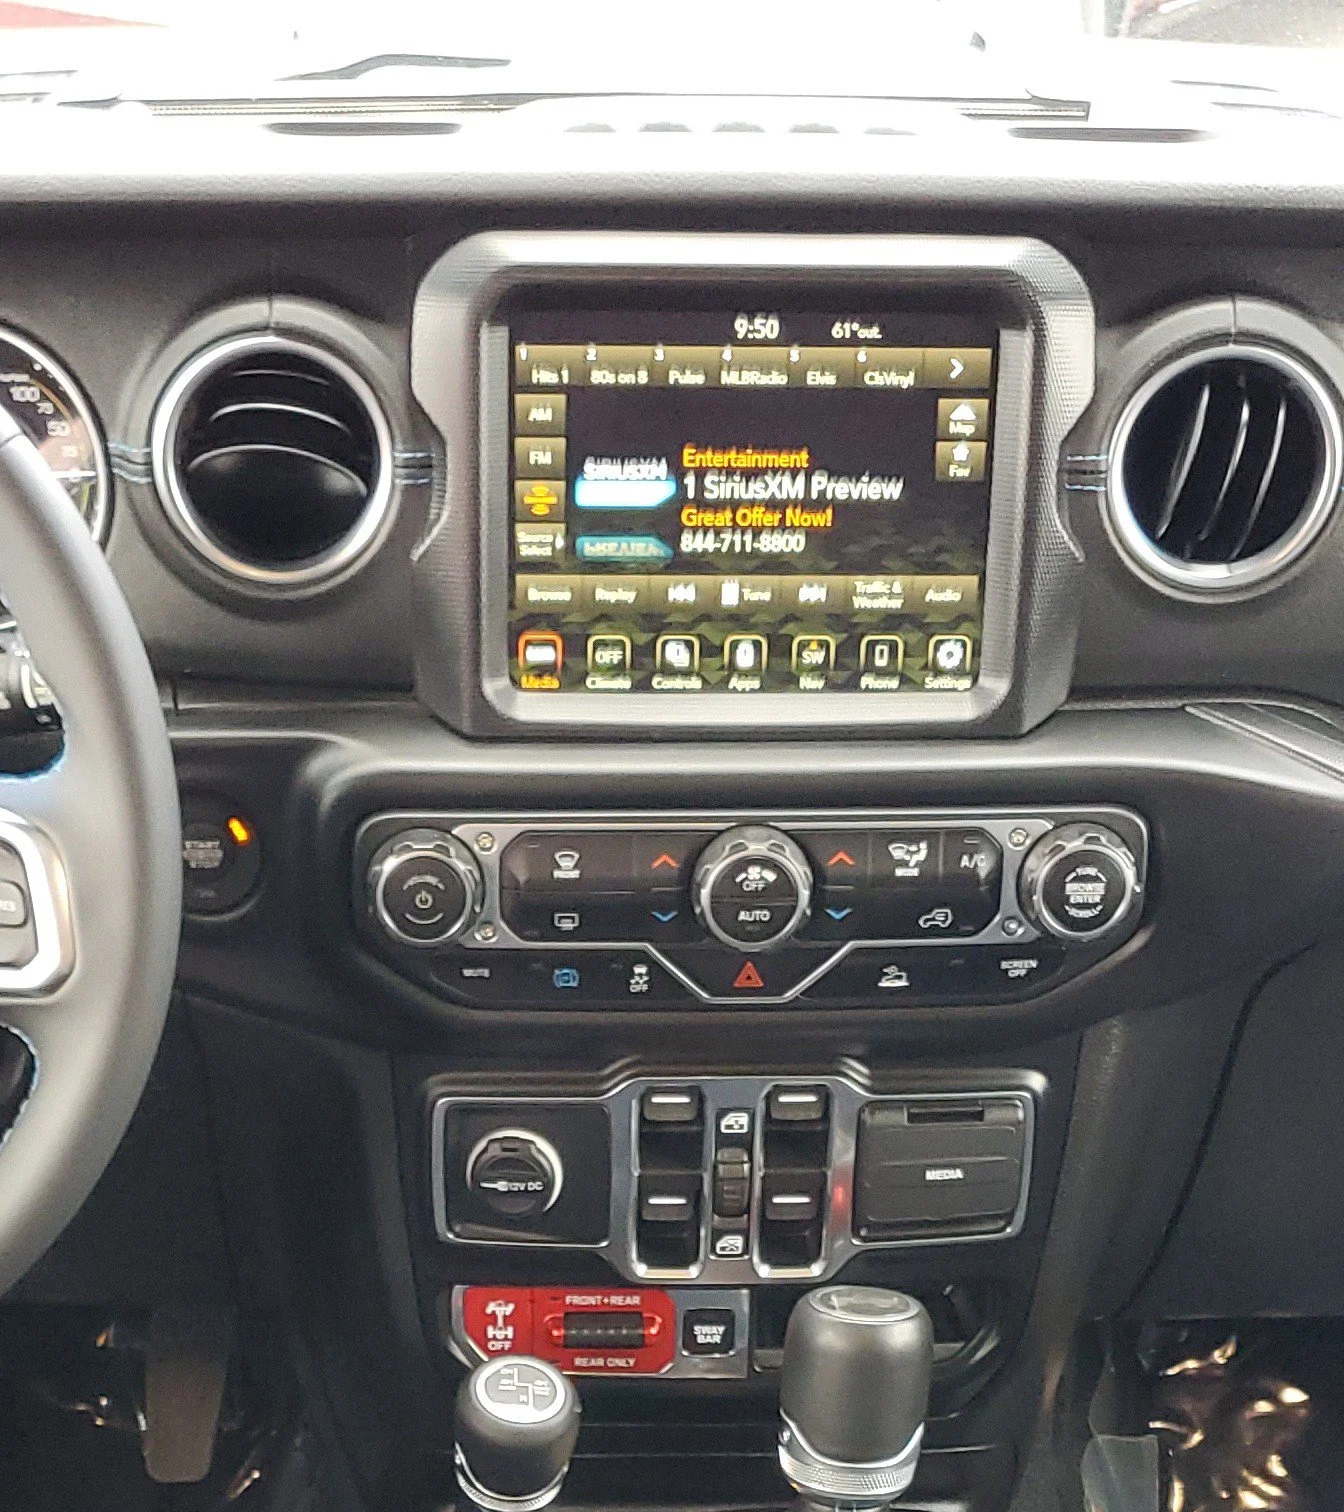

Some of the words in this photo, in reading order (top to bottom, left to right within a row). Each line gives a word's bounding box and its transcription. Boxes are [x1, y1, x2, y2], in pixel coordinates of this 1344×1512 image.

[733, 314, 780, 340] 9:50
[519, 344, 528, 361] 1
[586, 344, 598, 361] 2
[653, 344, 665, 362] 3
[721, 344, 732, 362] 4
[789, 345, 800, 362] 5
[856, 347, 867, 362] 6
[529, 448, 553, 465] FM
[682, 446, 809, 469] Entertainment
[683, 473, 696, 500] 1
[703, 473, 806, 500] SiriusXM
[811, 472, 904, 500] Preview
[681, 506, 733, 528] Great
[735, 506, 782, 528] Offer
[784, 504, 834, 528] Now!
[594, 648, 624, 665] OFF
[801, 650, 827, 664] SW
[960, 853, 986, 869] A/C
[742, 880, 768, 892] OFF
[738, 910, 771, 921] AUTO
[925, 1168, 963, 1181] MEDIA
[527, 1181, 544, 1191] DC
[693, 1324, 725, 1335] SWAY
[487, 1341, 512, 1351] OFF
[697, 1334, 721, 1345] BAR
[573, 1357, 605, 1367] REAR
[606, 1357, 636, 1367] ONLY
